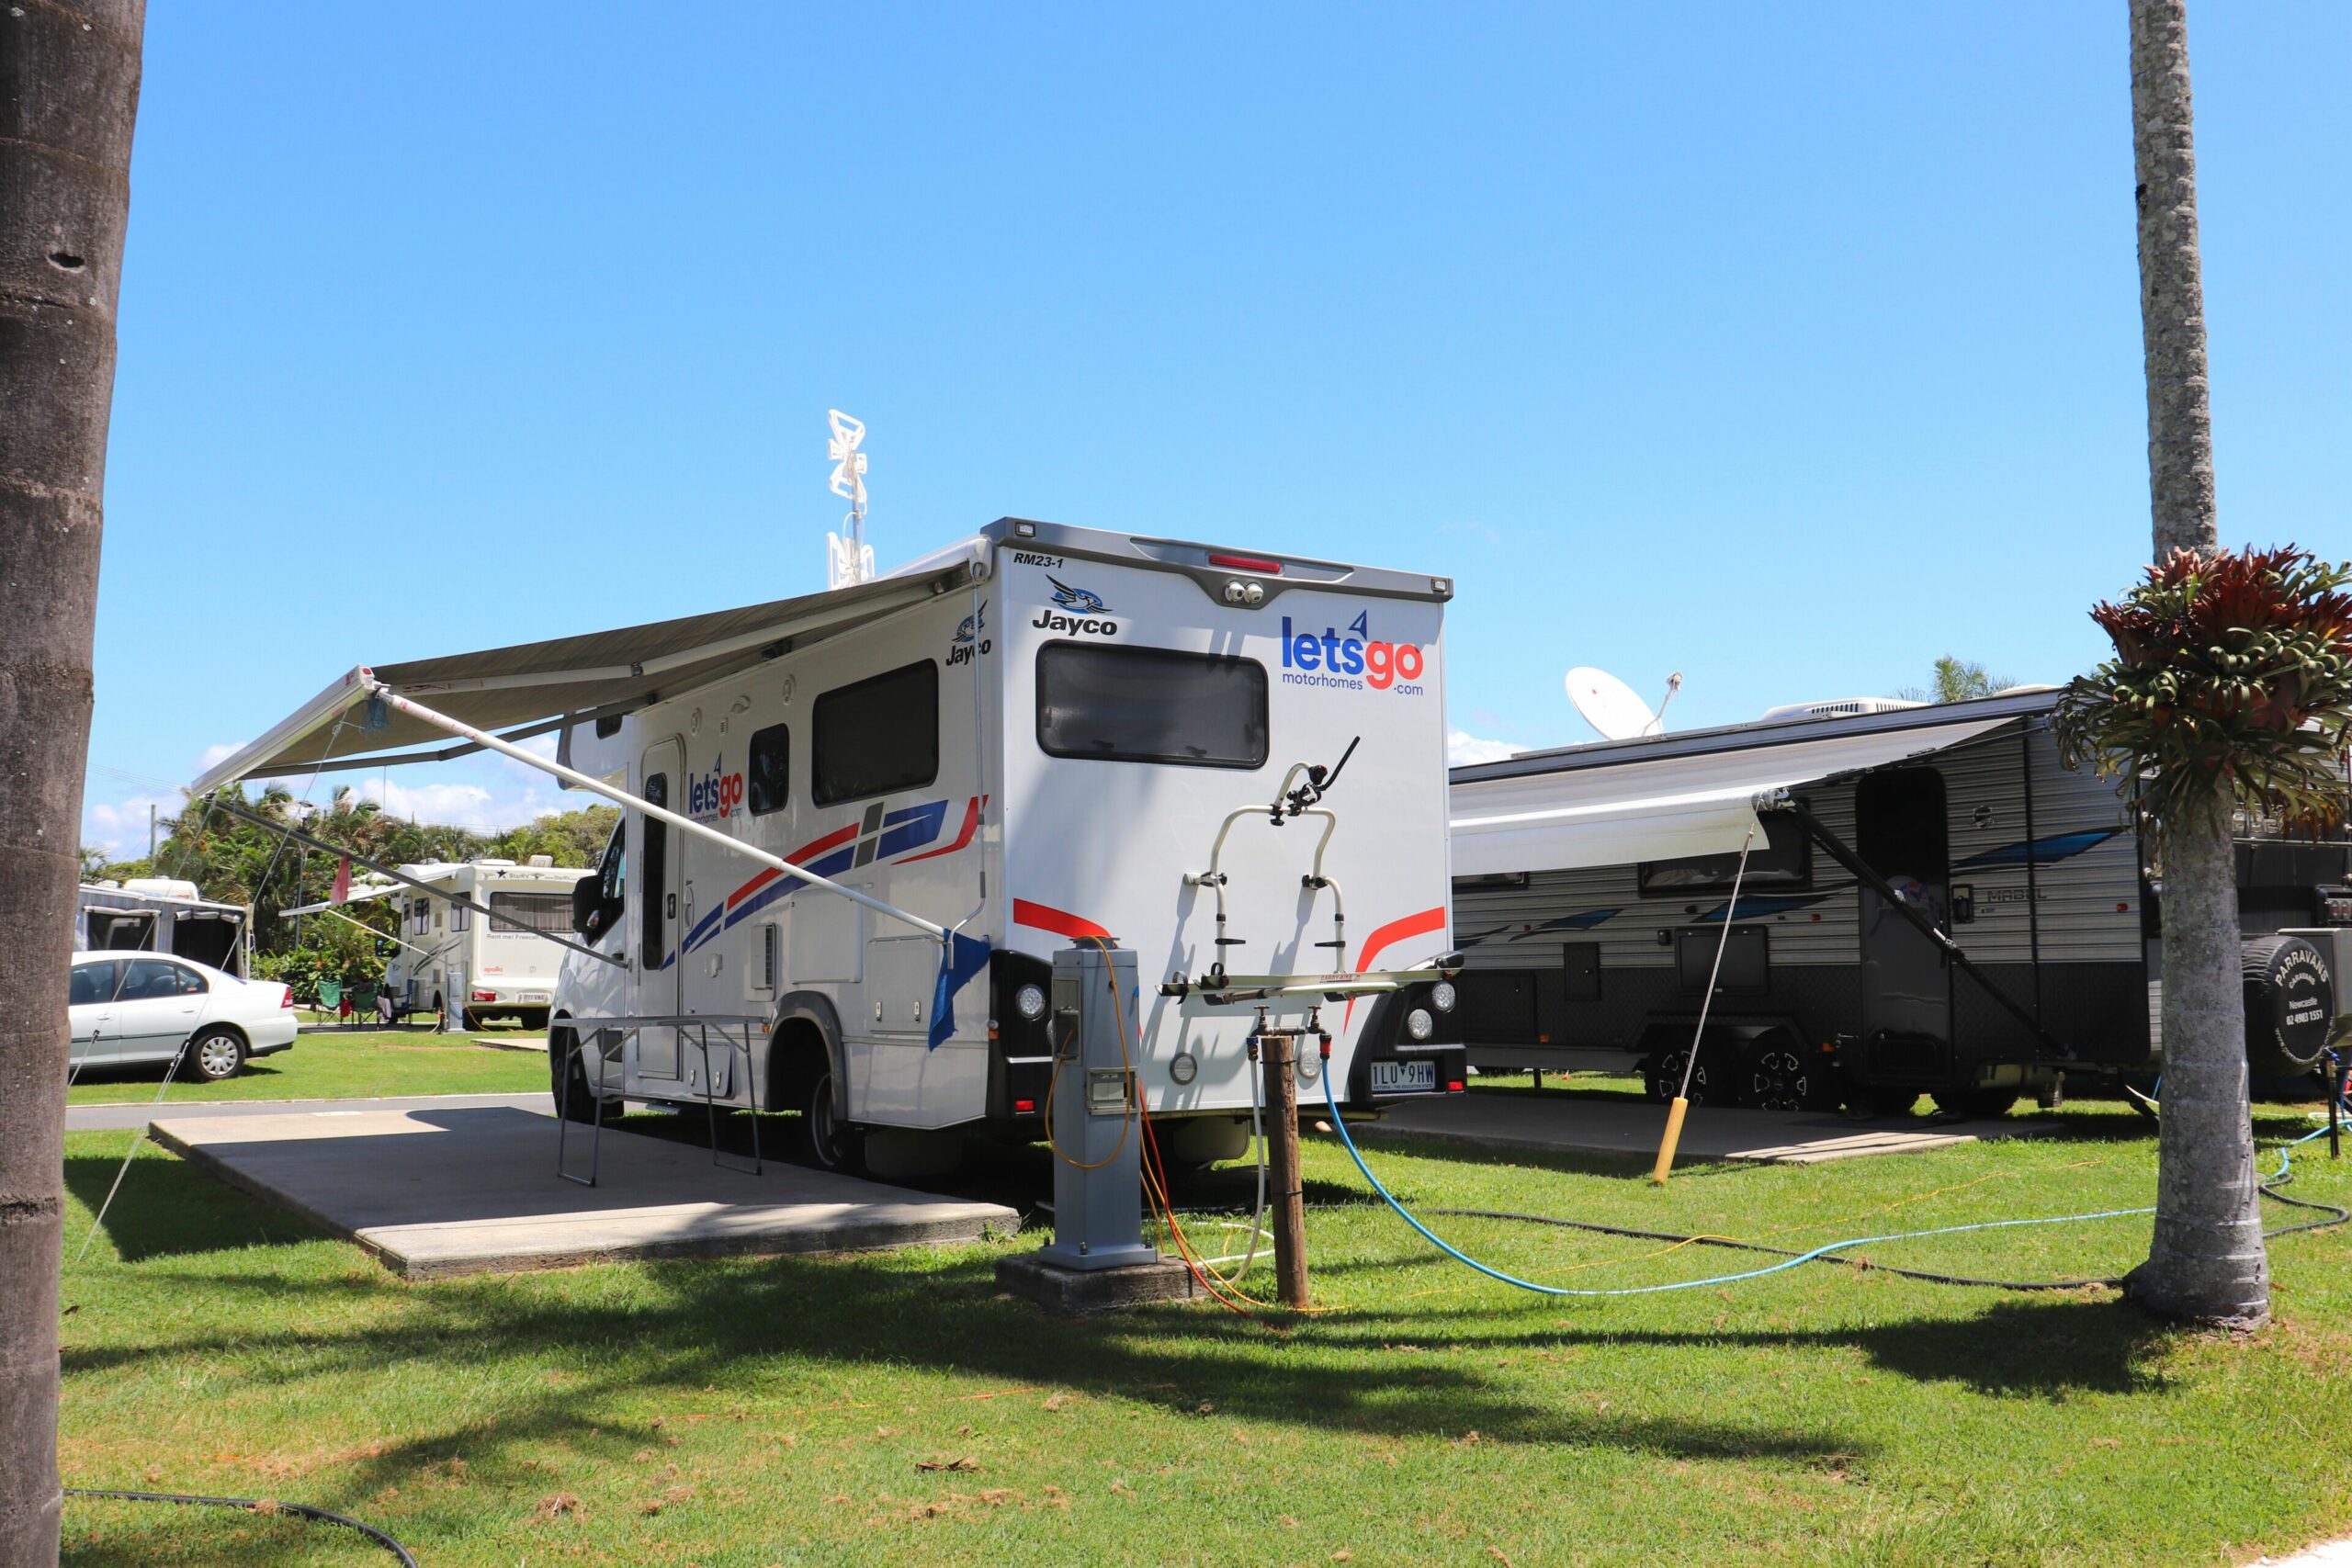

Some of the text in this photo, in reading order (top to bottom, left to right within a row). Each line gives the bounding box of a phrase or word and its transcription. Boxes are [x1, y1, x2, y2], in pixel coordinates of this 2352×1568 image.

[1013, 553, 1063, 569] RM23-1
[1033, 610, 1117, 637] Jayco
[1283, 673, 1363, 690] motorhomes
[1987, 889, 2047, 902] MABL
[2275, 950, 2329, 987] PARRAVANS
[2289, 973, 2315, 989] CARAVANS
[2289, 997, 2317, 1010] Newcastle
[2286, 1015, 2295, 1025] 02
[1374, 1065, 1433, 1084] 1LU 9HW
